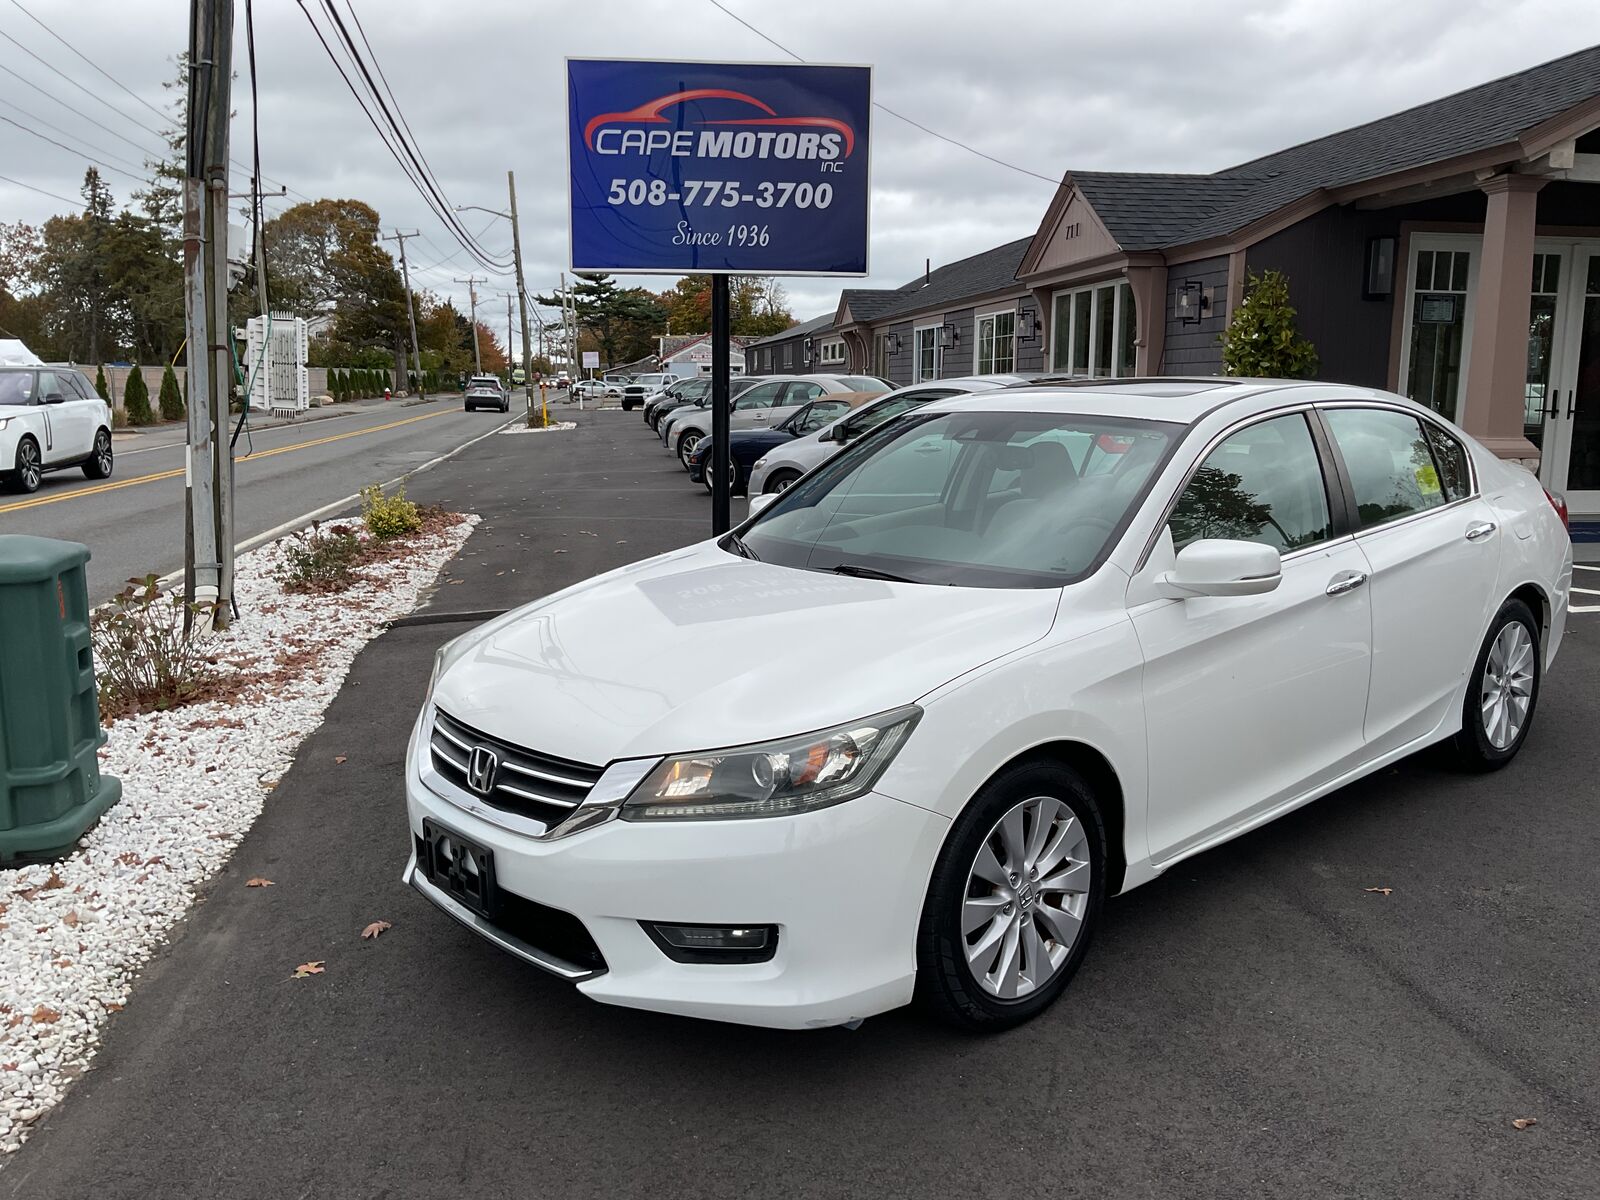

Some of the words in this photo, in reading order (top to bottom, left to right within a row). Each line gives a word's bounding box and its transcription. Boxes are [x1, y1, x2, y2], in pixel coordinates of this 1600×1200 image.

[596, 129, 694, 156] CAPE
[697, 131, 842, 160] MOTORS
[607, 178, 833, 209] 508-775-3700
[672, 220, 723, 246] Since
[727, 224, 770, 247] 1936
